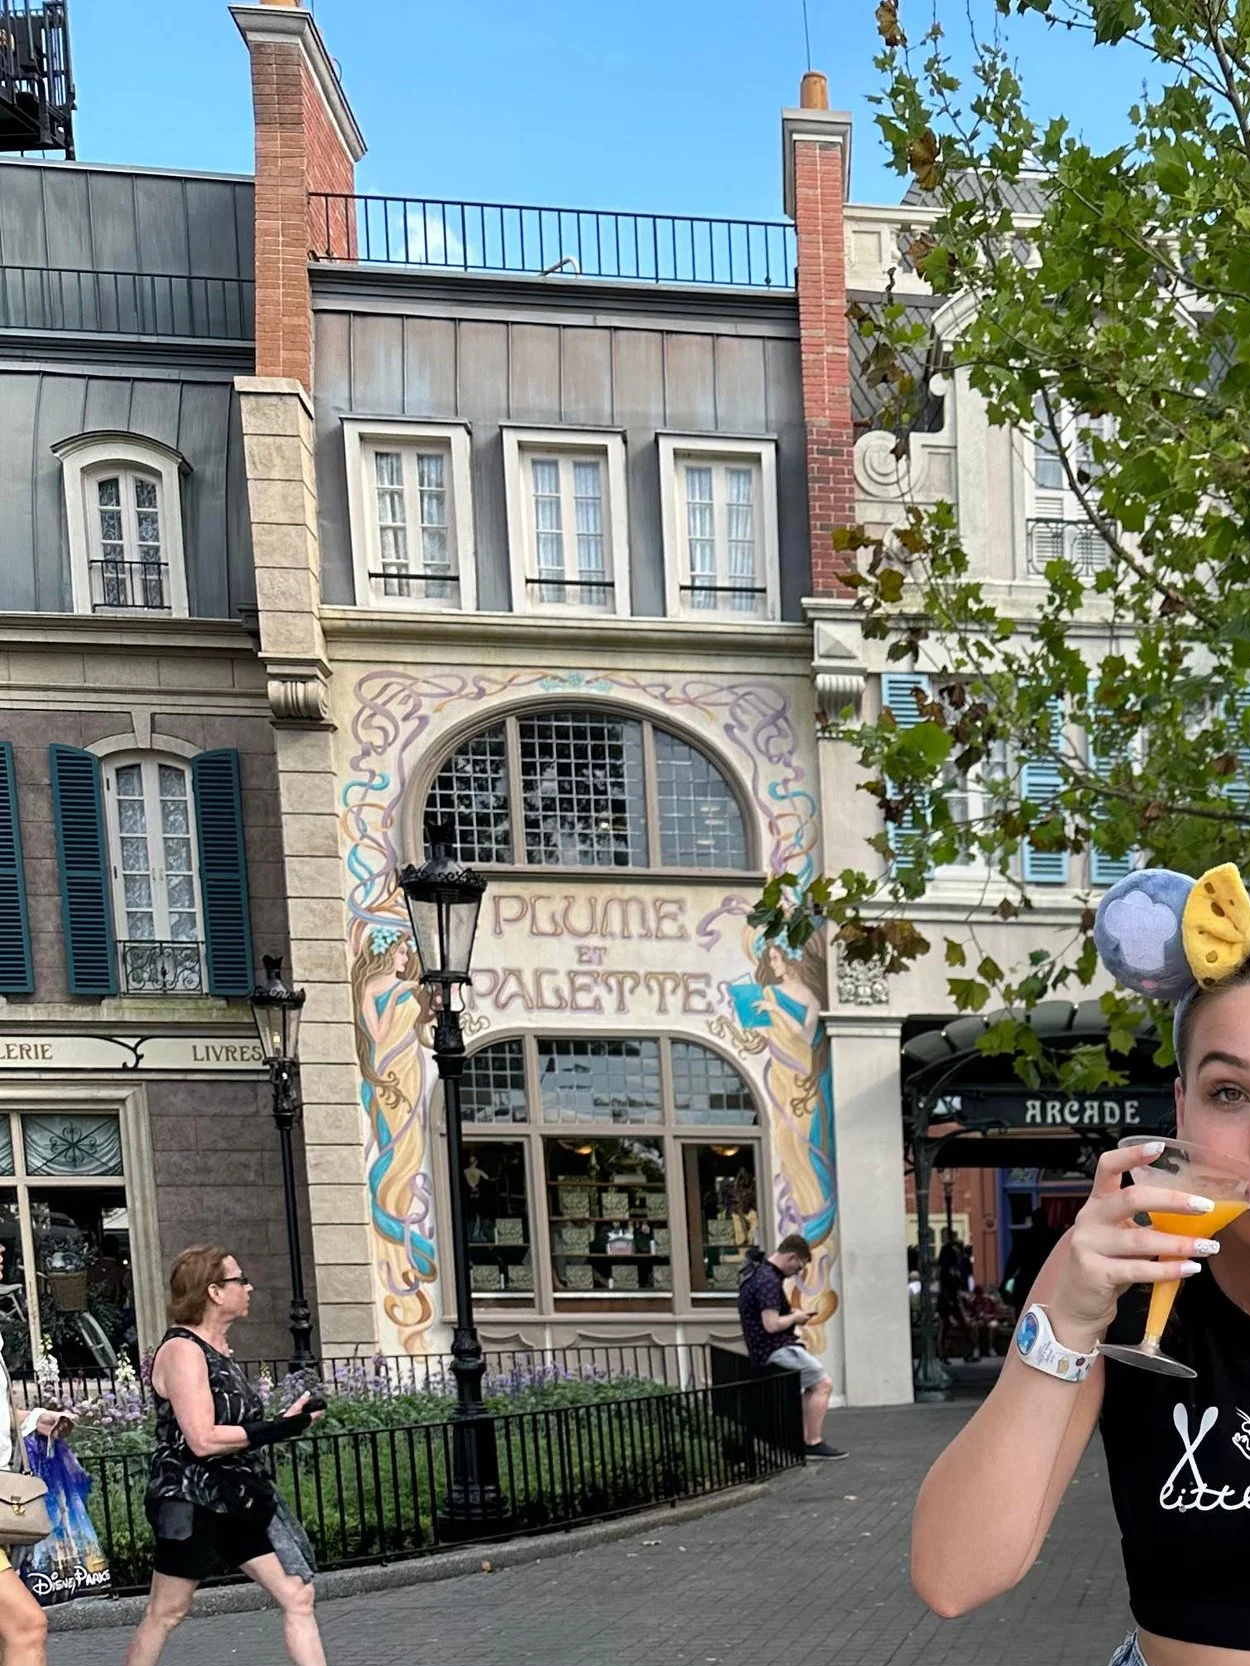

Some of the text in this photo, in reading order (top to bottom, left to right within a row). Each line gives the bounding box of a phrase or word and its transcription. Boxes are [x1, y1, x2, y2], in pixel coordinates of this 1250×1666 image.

[492, 894, 689, 940] PLUME
[576, 945, 607, 966] ET
[468, 968, 717, 1014] PALETTE
[192, 1045, 263, 1062] LIVRES
[1025, 1100, 1140, 1124] ARCADE
